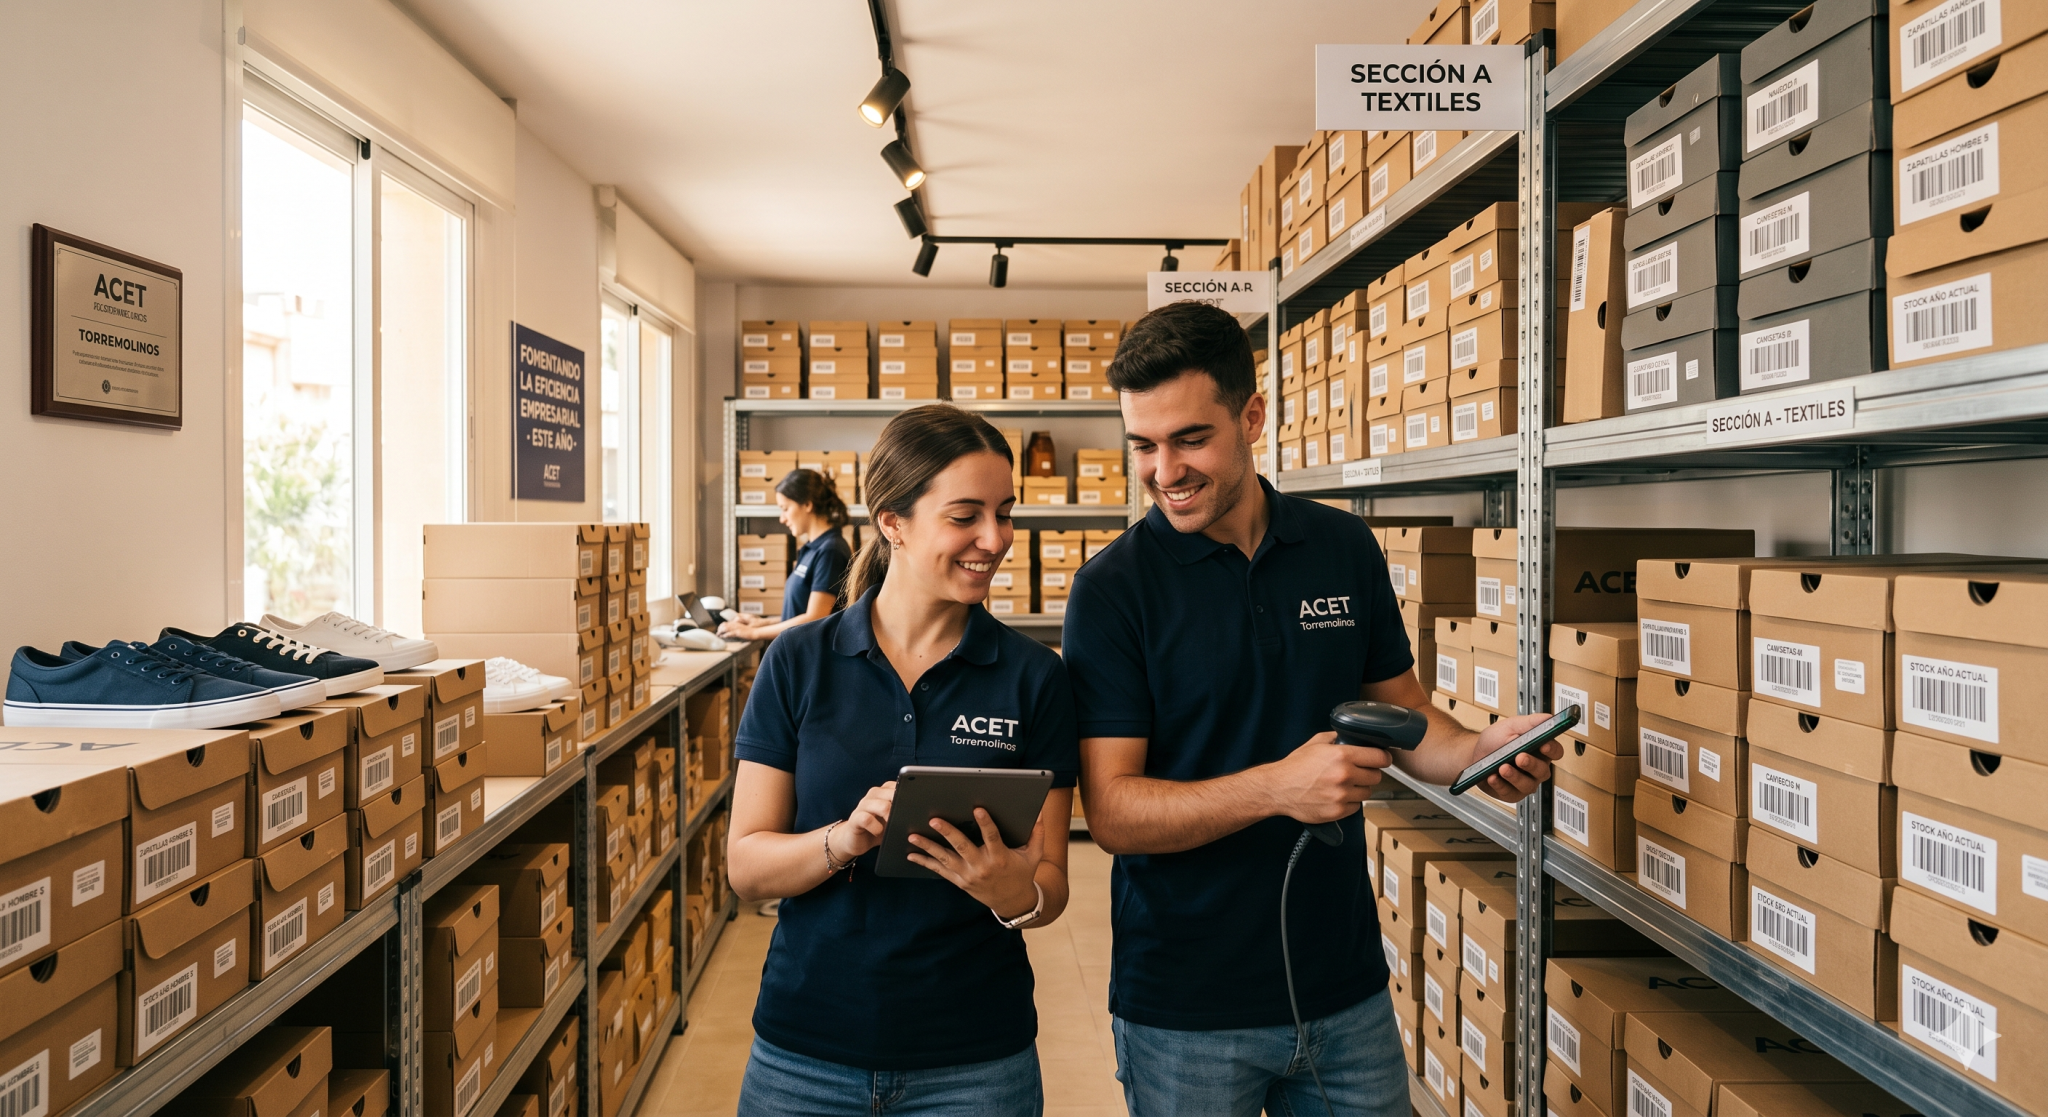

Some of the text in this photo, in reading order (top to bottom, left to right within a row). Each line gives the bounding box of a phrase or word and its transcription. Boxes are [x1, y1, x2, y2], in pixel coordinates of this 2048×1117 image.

[1350, 59, 1493, 84] SECCIÓN A
[1361, 92, 1481, 112] TEXTILES
[1906, 149, 1948, 172] ZAPATILLAS
[94, 273, 147, 308] ACET
[1164, 279, 1228, 293] SECCIÓN
[1903, 284, 1979, 310] STOCK AÑO ACTUAL
[78, 328, 160, 357] TORREMOLINOS
[520, 344, 581, 381] FOMENTANDO
[520, 371, 580, 404] LA EFICIENCIA
[520, 398, 581, 428] EMPRESARIAL
[1712, 410, 1761, 433] SECCIÓN
[1764, 411, 1773, 426] A
[1784, 399, 1845, 424] TEXTILES
[532, 428, 554, 449] ESTE
[543, 464, 561, 481] ACET
[1299, 596, 1350, 618] ACET
[1300, 618, 1355, 631] Torremolinos
[1910, 662, 1988, 683] STOCK AÑO ACTUAL
[951, 714, 1019, 738] ACET
[950, 735, 1017, 752] Torremolinos
[1911, 820, 1986, 853] STOCK AÑO ACTUAL
[1911, 975, 1985, 1019] STOCK AÑO ACTUAL
